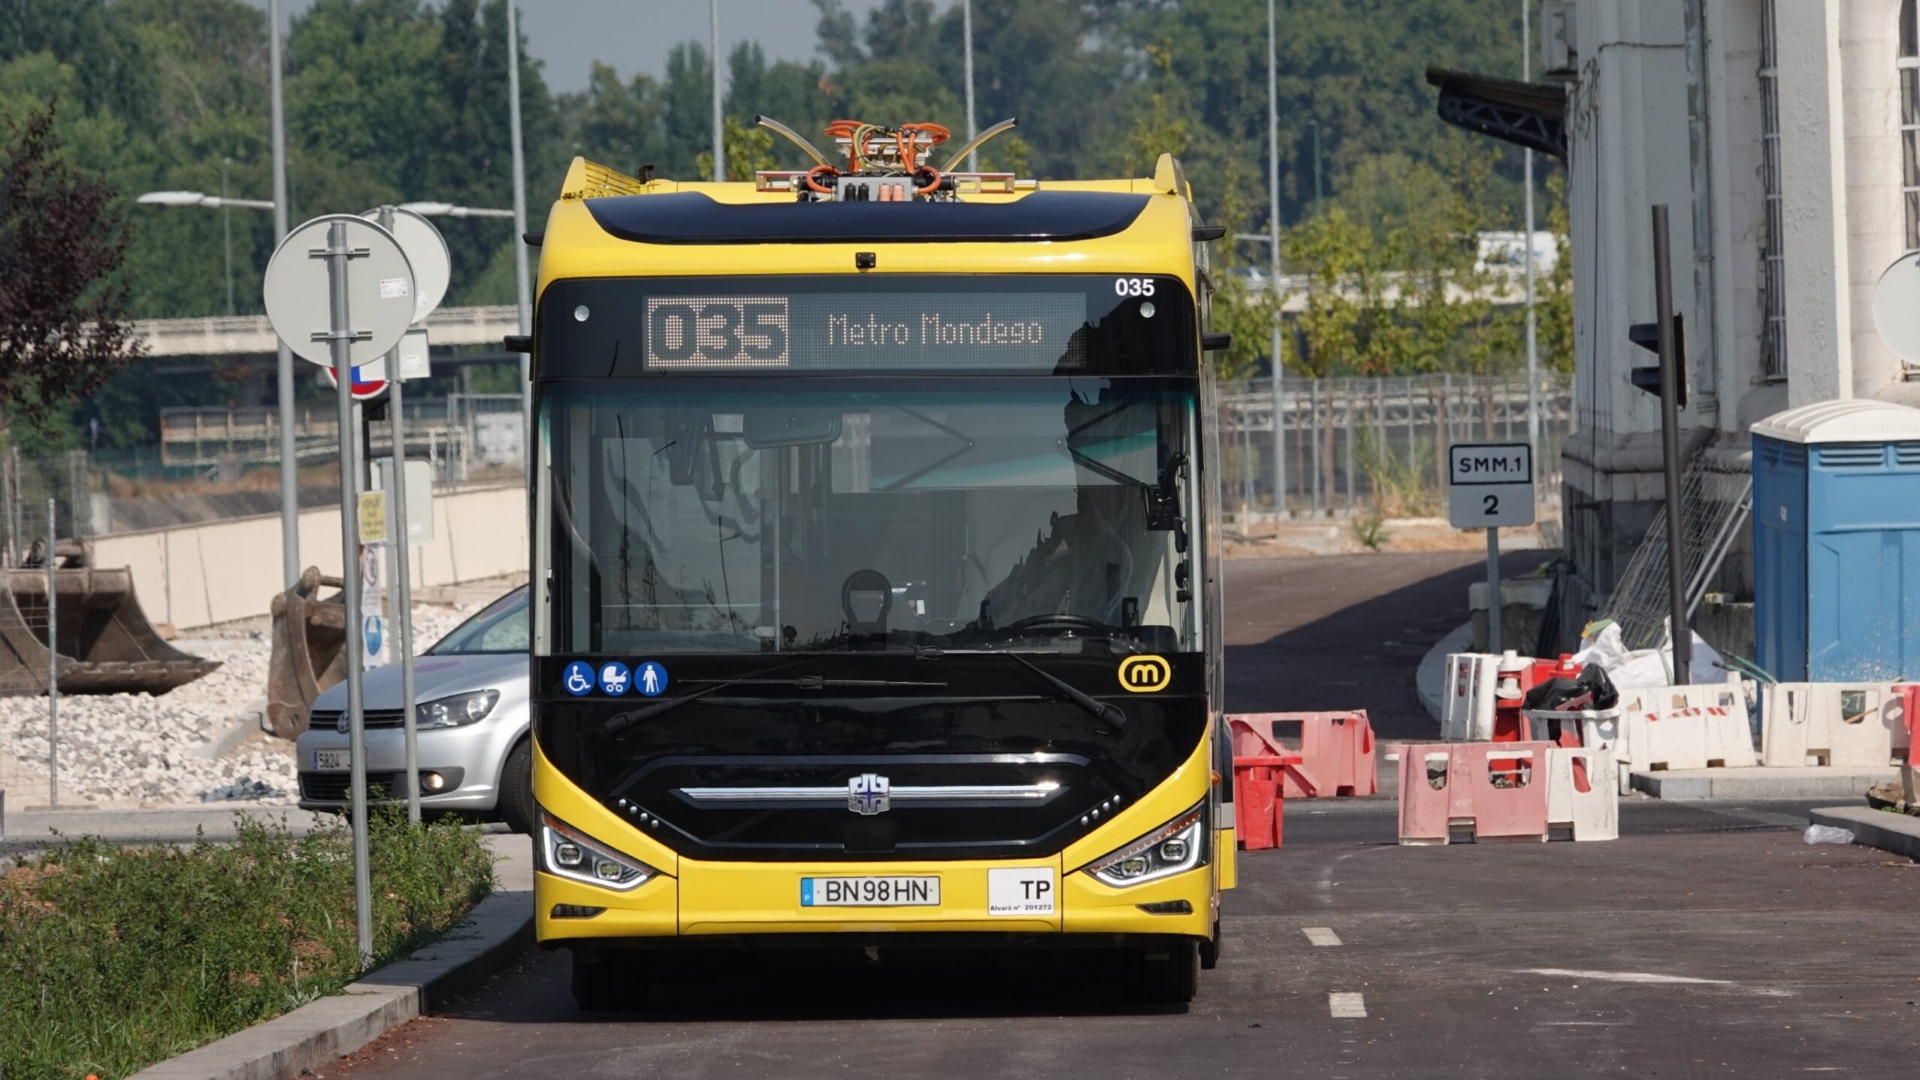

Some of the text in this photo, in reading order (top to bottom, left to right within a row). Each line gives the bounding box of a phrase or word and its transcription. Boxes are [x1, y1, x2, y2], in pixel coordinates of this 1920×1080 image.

[1115, 278, 1155, 296] 035
[652, 301, 786, 364] 035
[829, 313, 1042, 345] Metro Mondego
[1459, 457, 1521, 473] SMM.1
[1483, 495, 1499, 515] 2
[319, 753, 340, 768] 5824
[1020, 881, 1051, 900] TP
